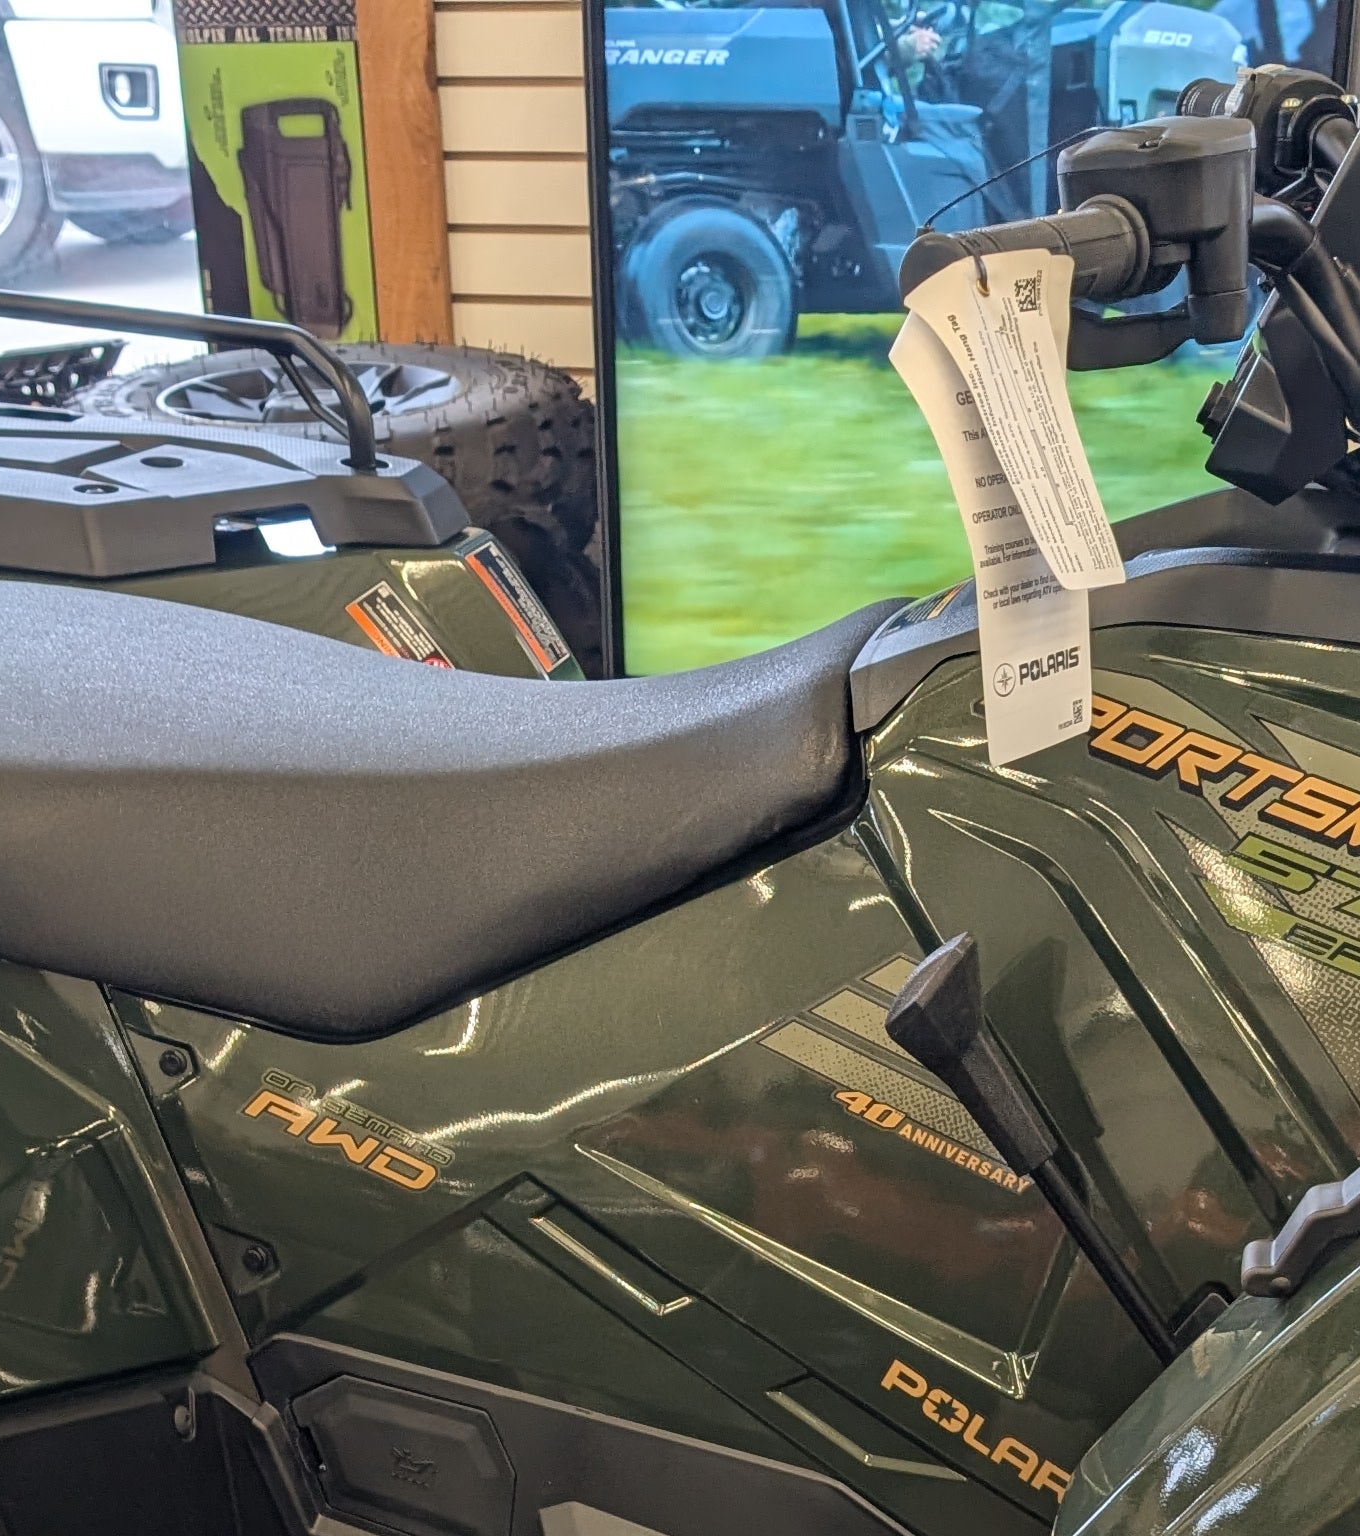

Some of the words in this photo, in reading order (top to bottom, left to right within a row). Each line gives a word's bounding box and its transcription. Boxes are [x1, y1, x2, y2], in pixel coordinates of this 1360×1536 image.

[605, 49, 730, 66] RANGER
[946, 313, 961, 333] Tag
[958, 333, 975, 361] Hang
[972, 508, 1008, 524] OPERATOR
[1018, 646, 1081, 686] POLARIS
[243, 1089, 439, 1192] AWD
[898, 1122, 1032, 1194] ANNIVERSARY
[880, 1358, 1074, 1504] POLAR
